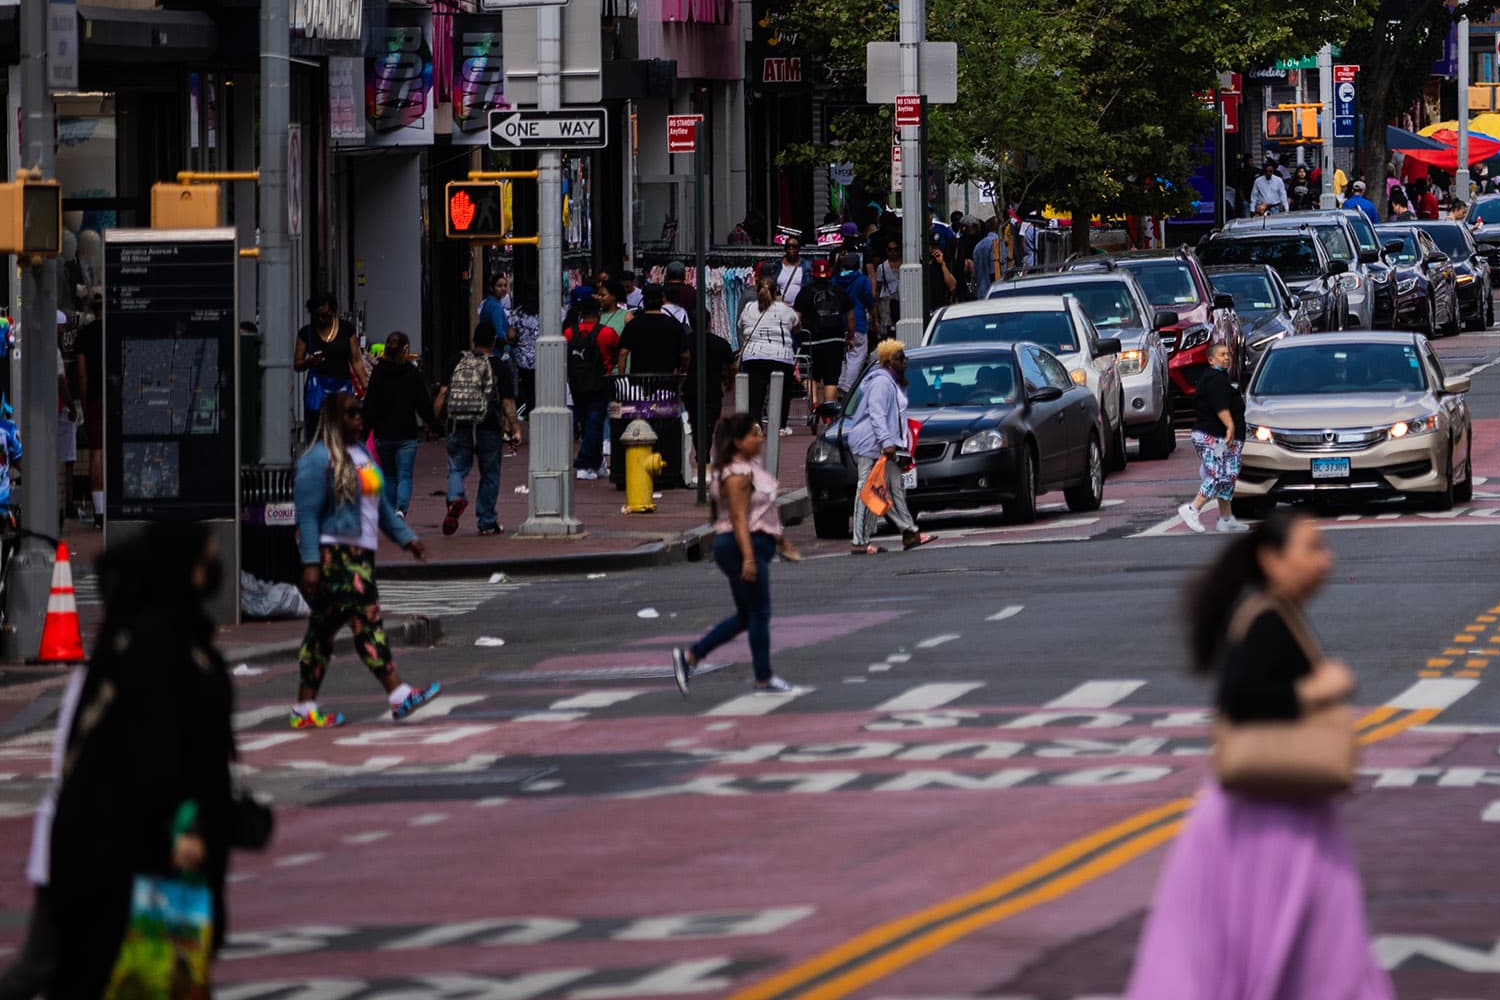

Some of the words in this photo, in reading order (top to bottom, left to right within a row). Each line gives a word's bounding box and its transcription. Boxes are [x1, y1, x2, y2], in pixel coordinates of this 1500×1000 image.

[763, 57, 801, 83] ATM
[505, 122, 539, 136] ONE
[559, 121, 595, 136] WAY
